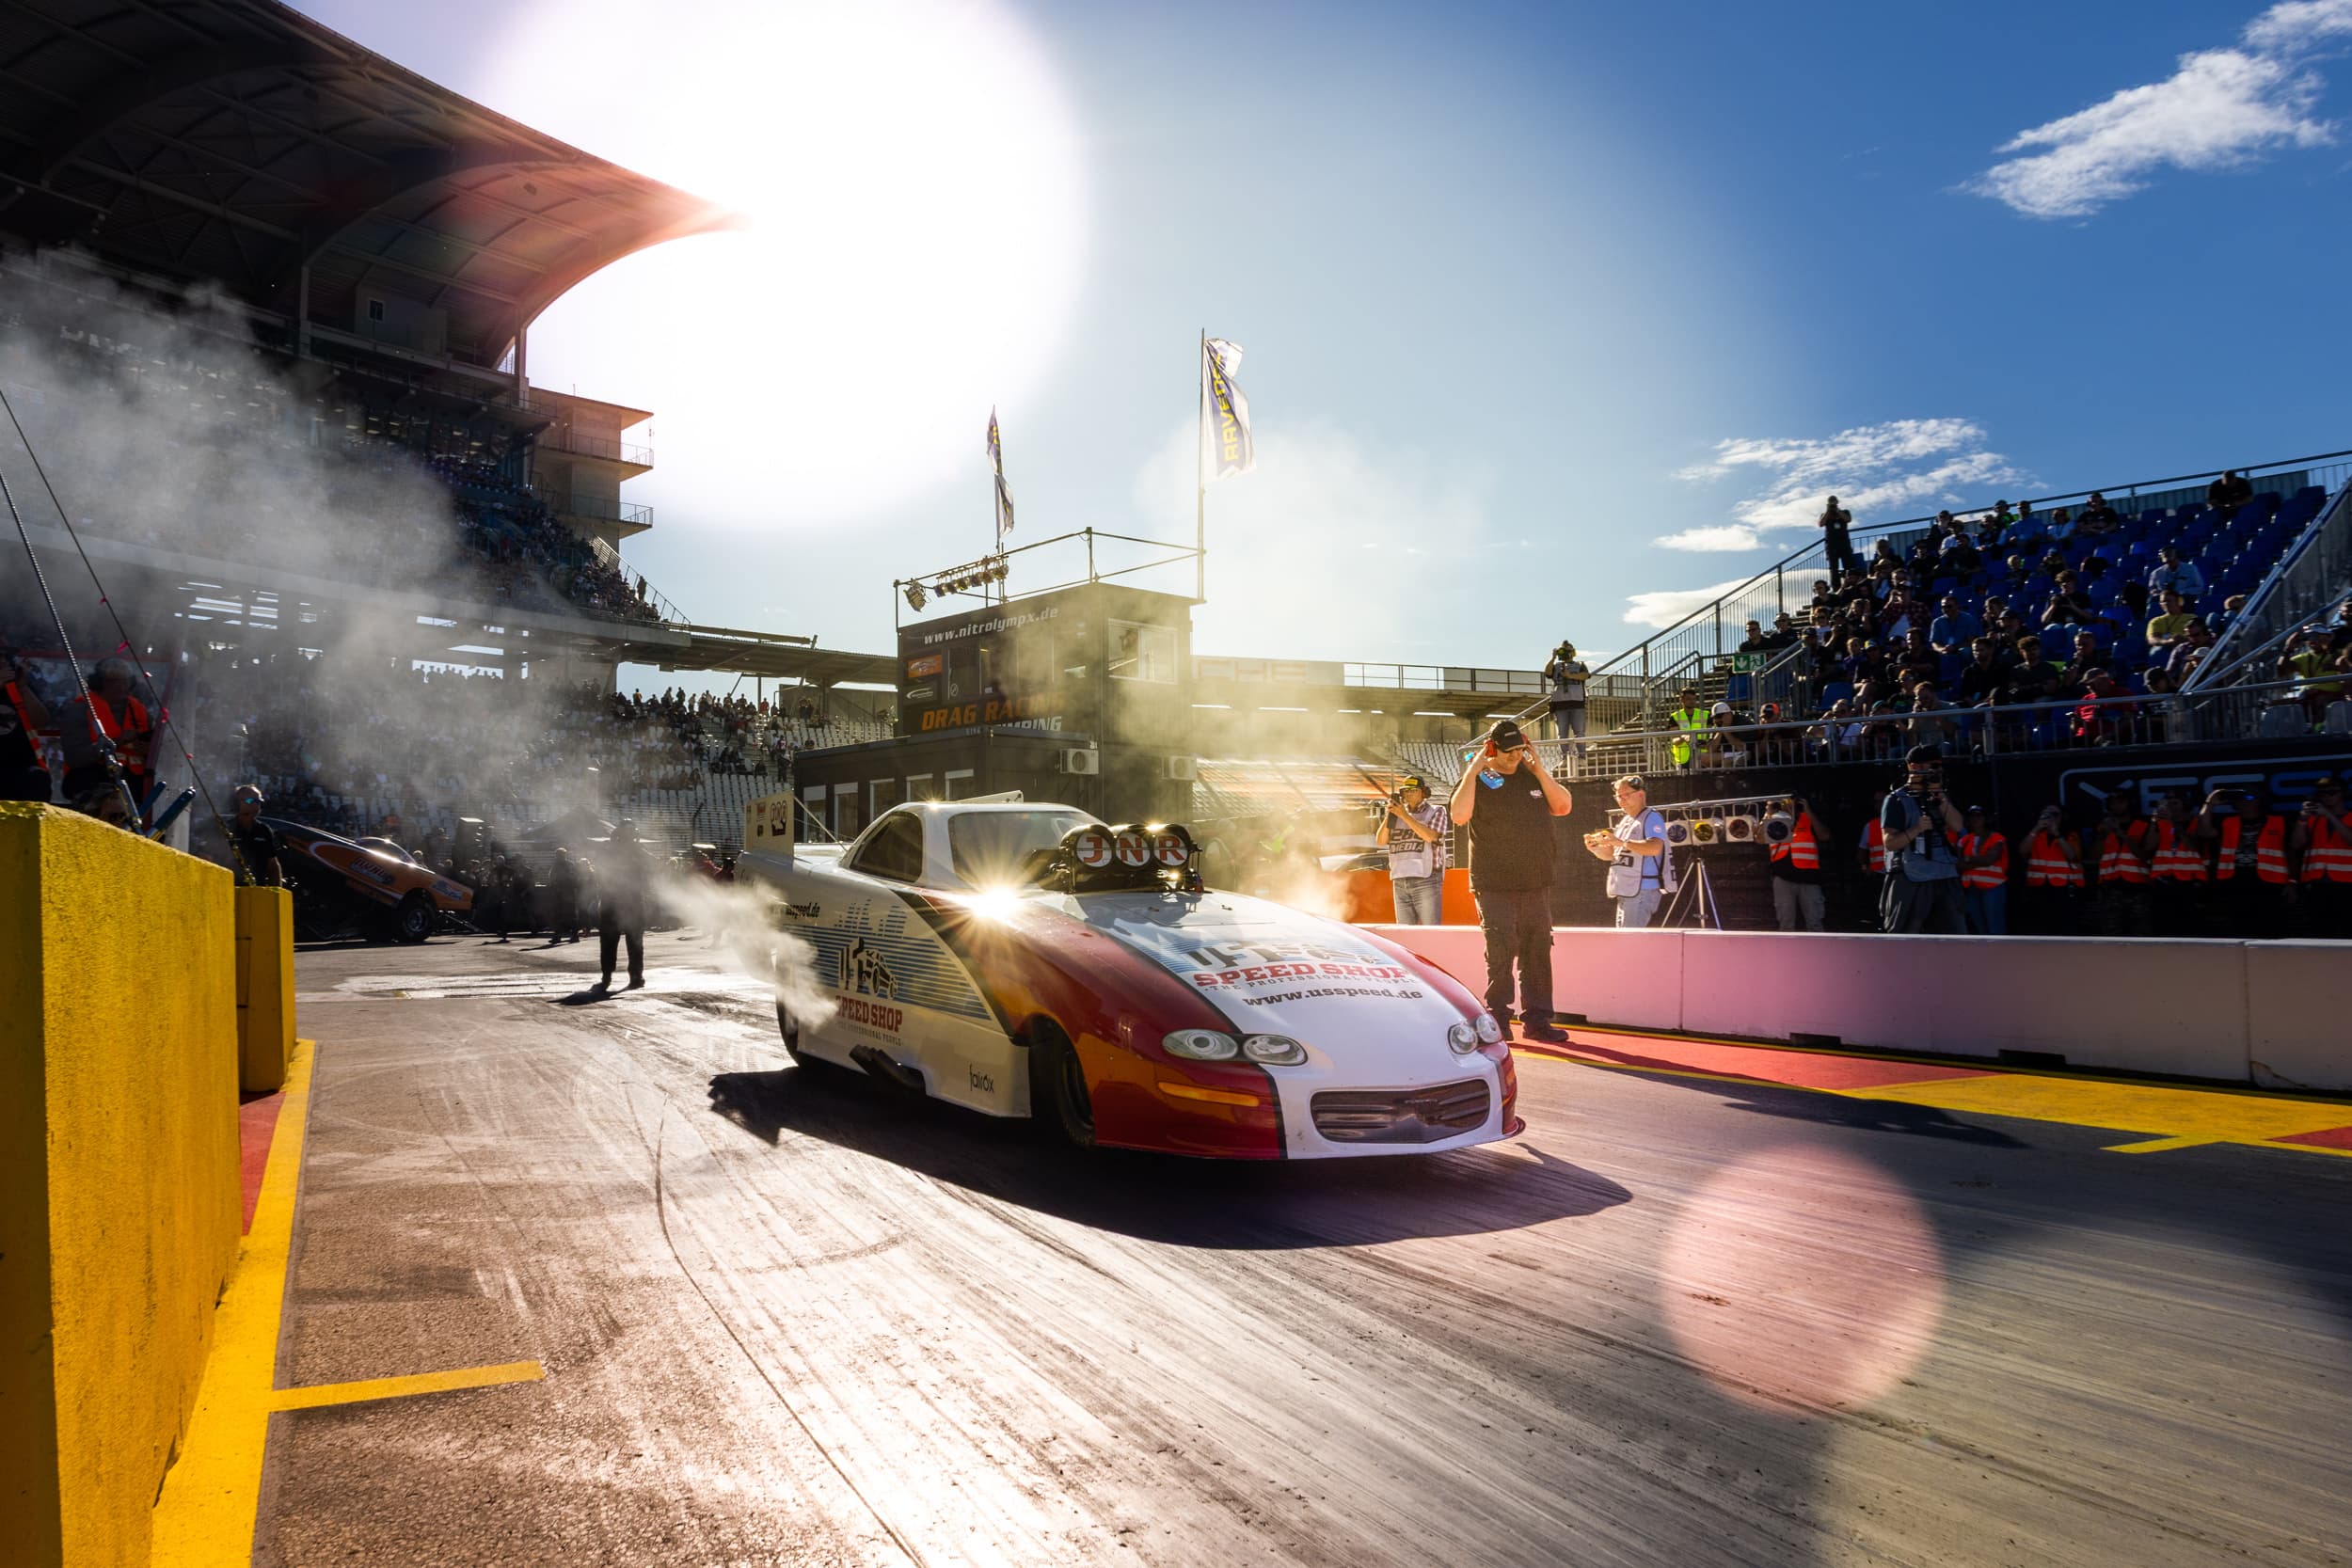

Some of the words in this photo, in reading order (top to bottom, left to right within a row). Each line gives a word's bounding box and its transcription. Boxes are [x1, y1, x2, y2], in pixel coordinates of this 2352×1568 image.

[924, 607, 1058, 645] www.nitrolympx.de
[921, 703, 977, 731] DRAG
[1390, 841, 1423, 853] MEDIA
[1193, 963, 1316, 987] SPEED
[1319, 963, 1408, 979] SHOP
[1242, 988, 1423, 1006] www.usspeed.de
[870, 1003, 903, 1033] SHOP
